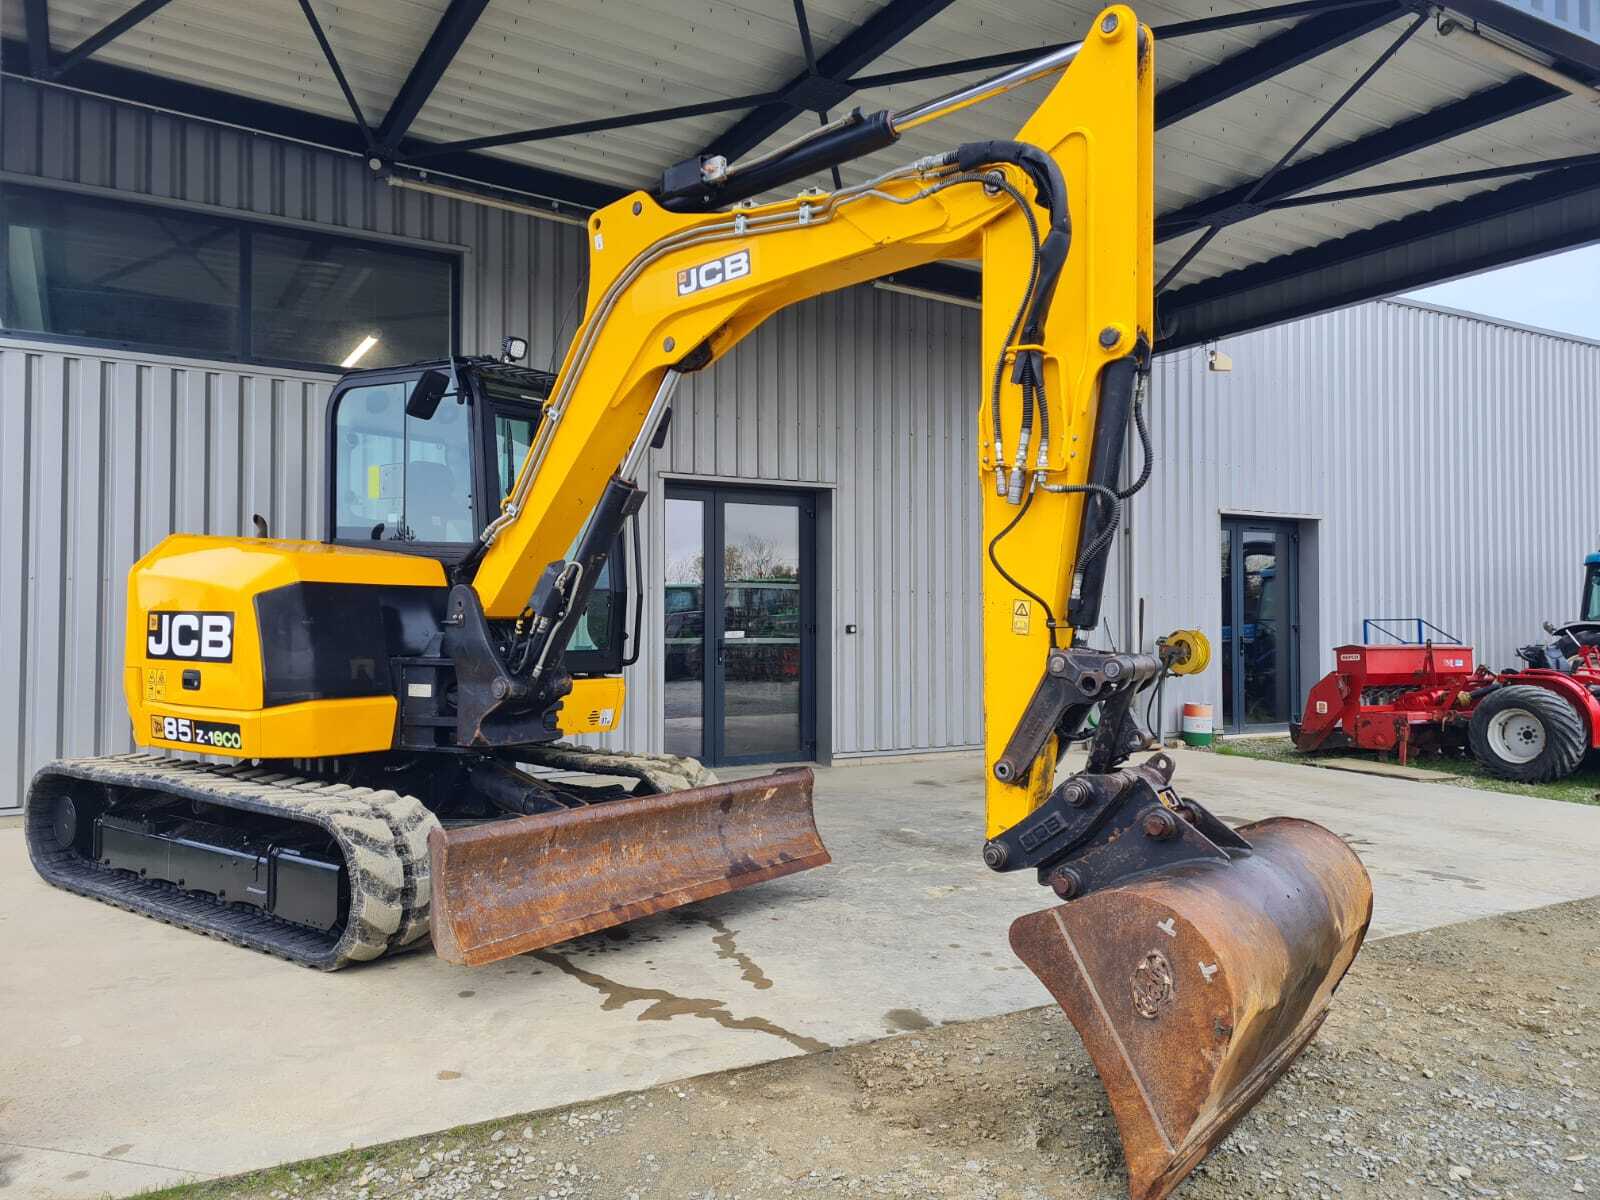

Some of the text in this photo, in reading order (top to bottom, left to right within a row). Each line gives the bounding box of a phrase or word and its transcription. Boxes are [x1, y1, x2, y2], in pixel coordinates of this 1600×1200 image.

[679, 251, 749, 295] JCB
[148, 614, 232, 658] JCB
[163, 716, 192, 742] 85
